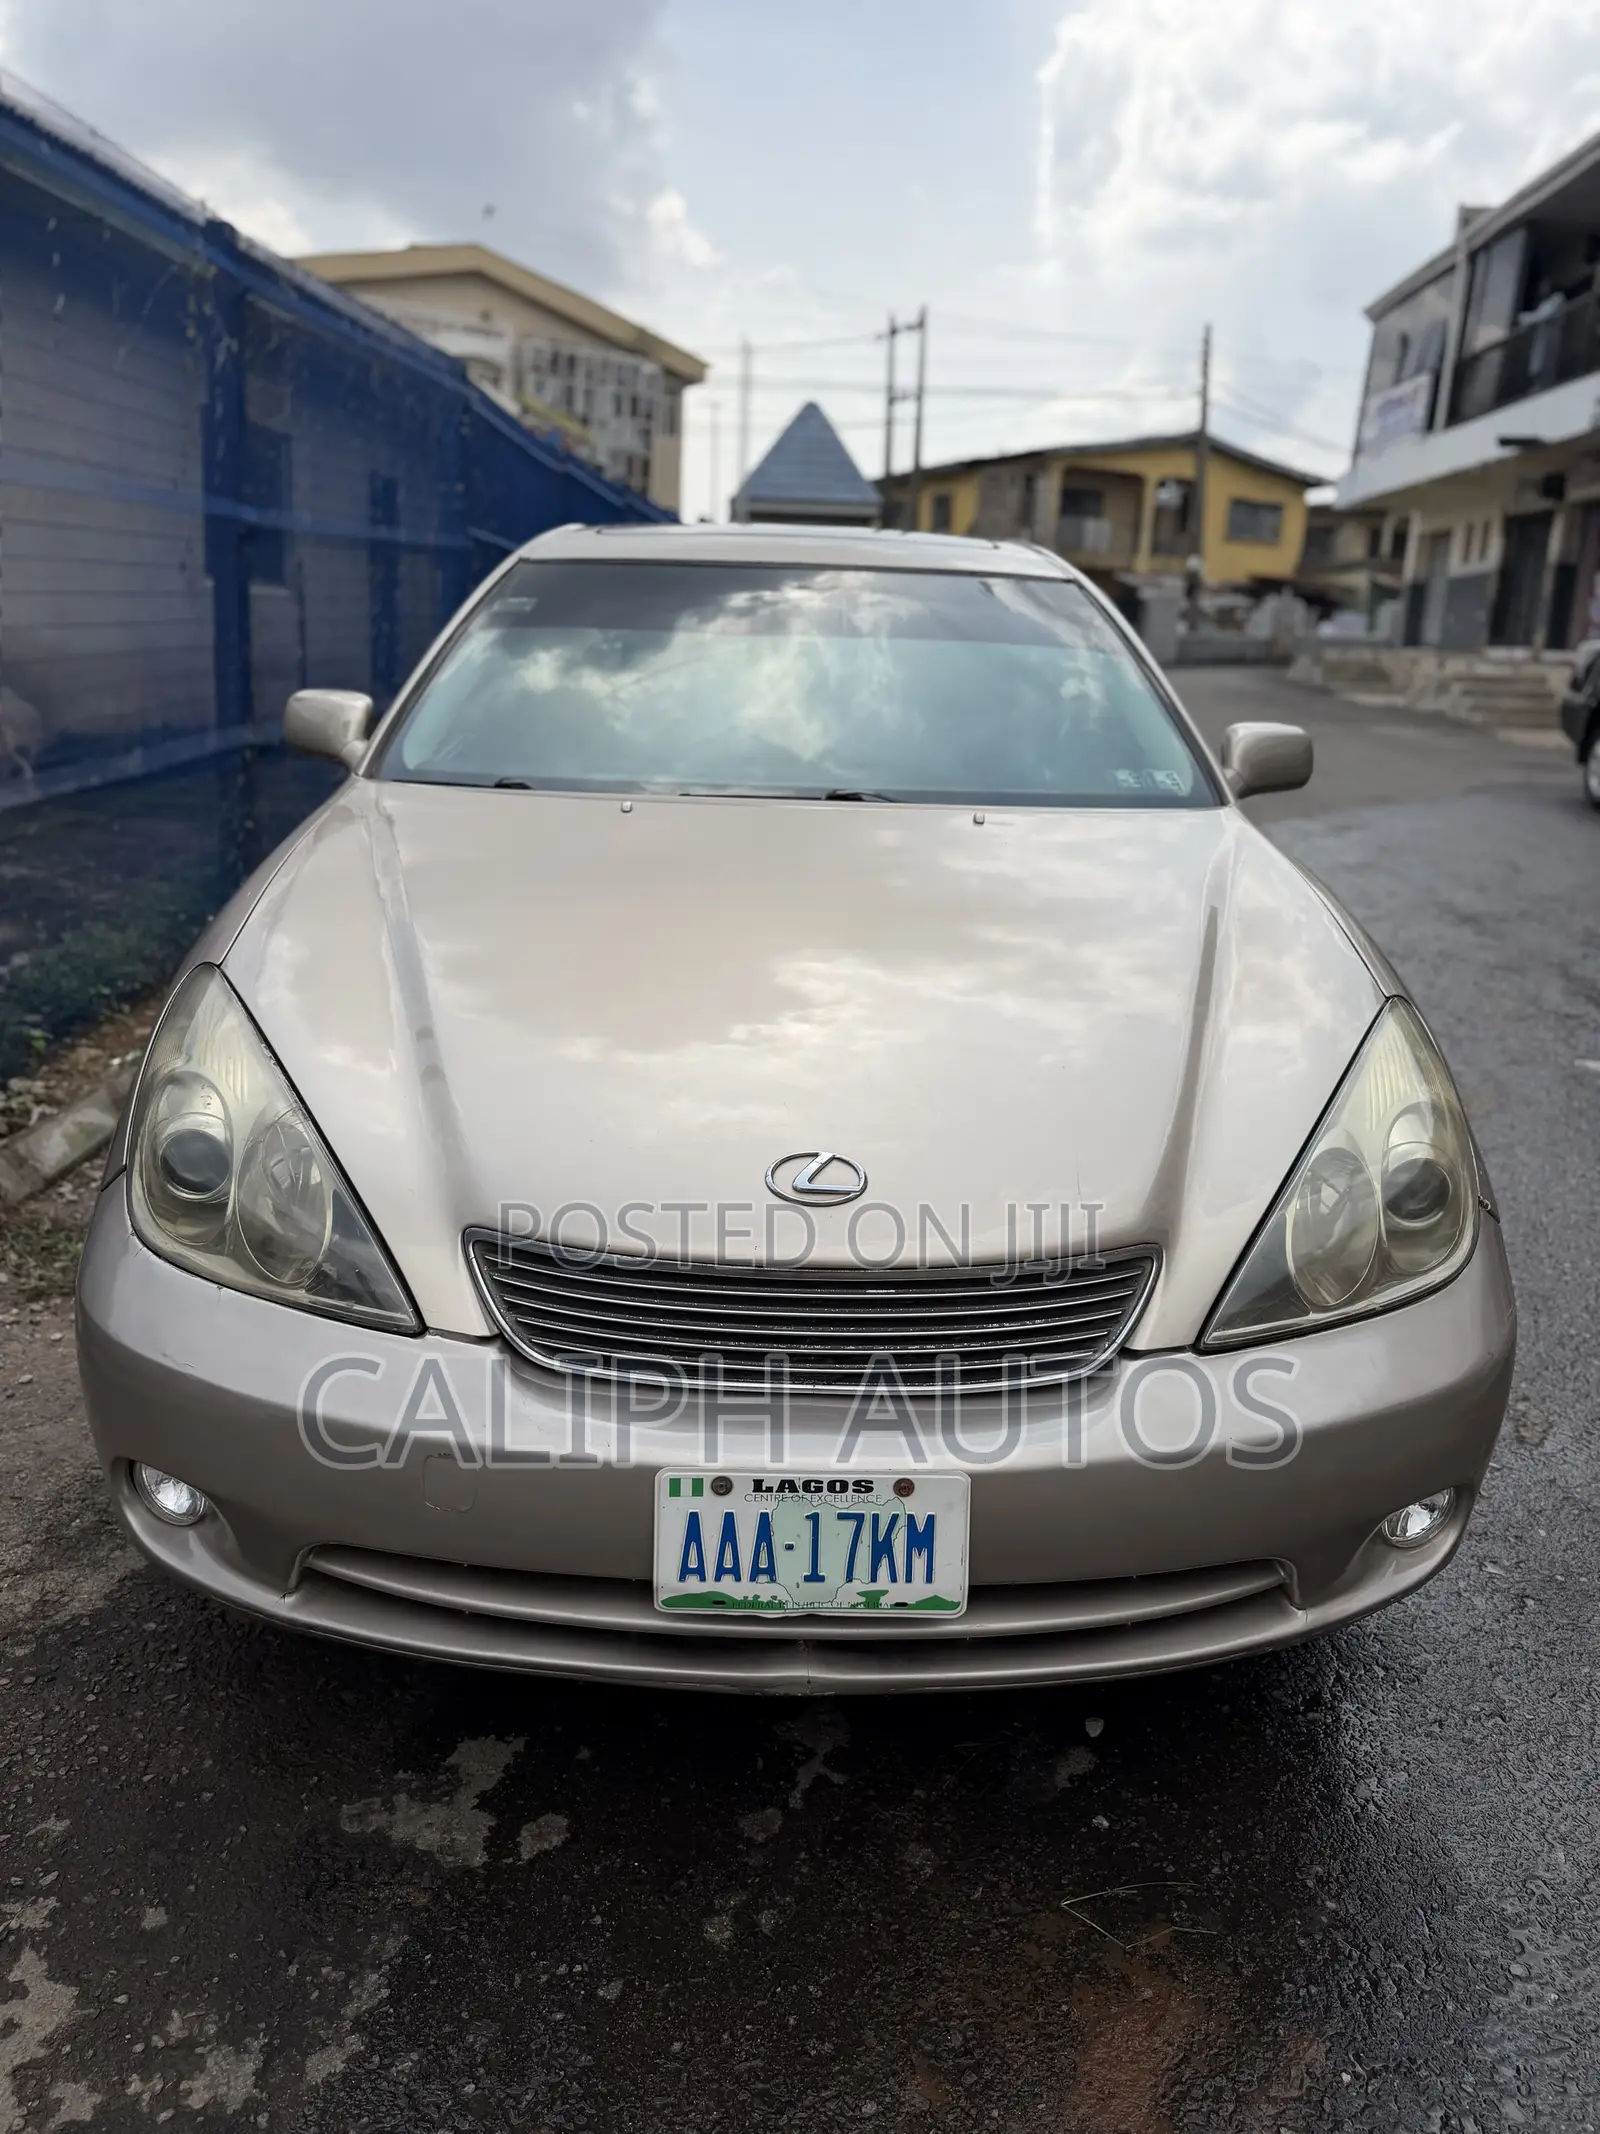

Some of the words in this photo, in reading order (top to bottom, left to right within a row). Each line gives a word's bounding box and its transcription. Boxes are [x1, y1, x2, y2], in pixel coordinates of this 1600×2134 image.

[752, 1479, 874, 1494] LAGOS
[744, 1493, 788, 1503] CENTRE
[790, 1493, 807, 1503] OF
[810, 1494, 882, 1503] EXCELLENCE
[678, 1511, 936, 1583] AAA-17KM
